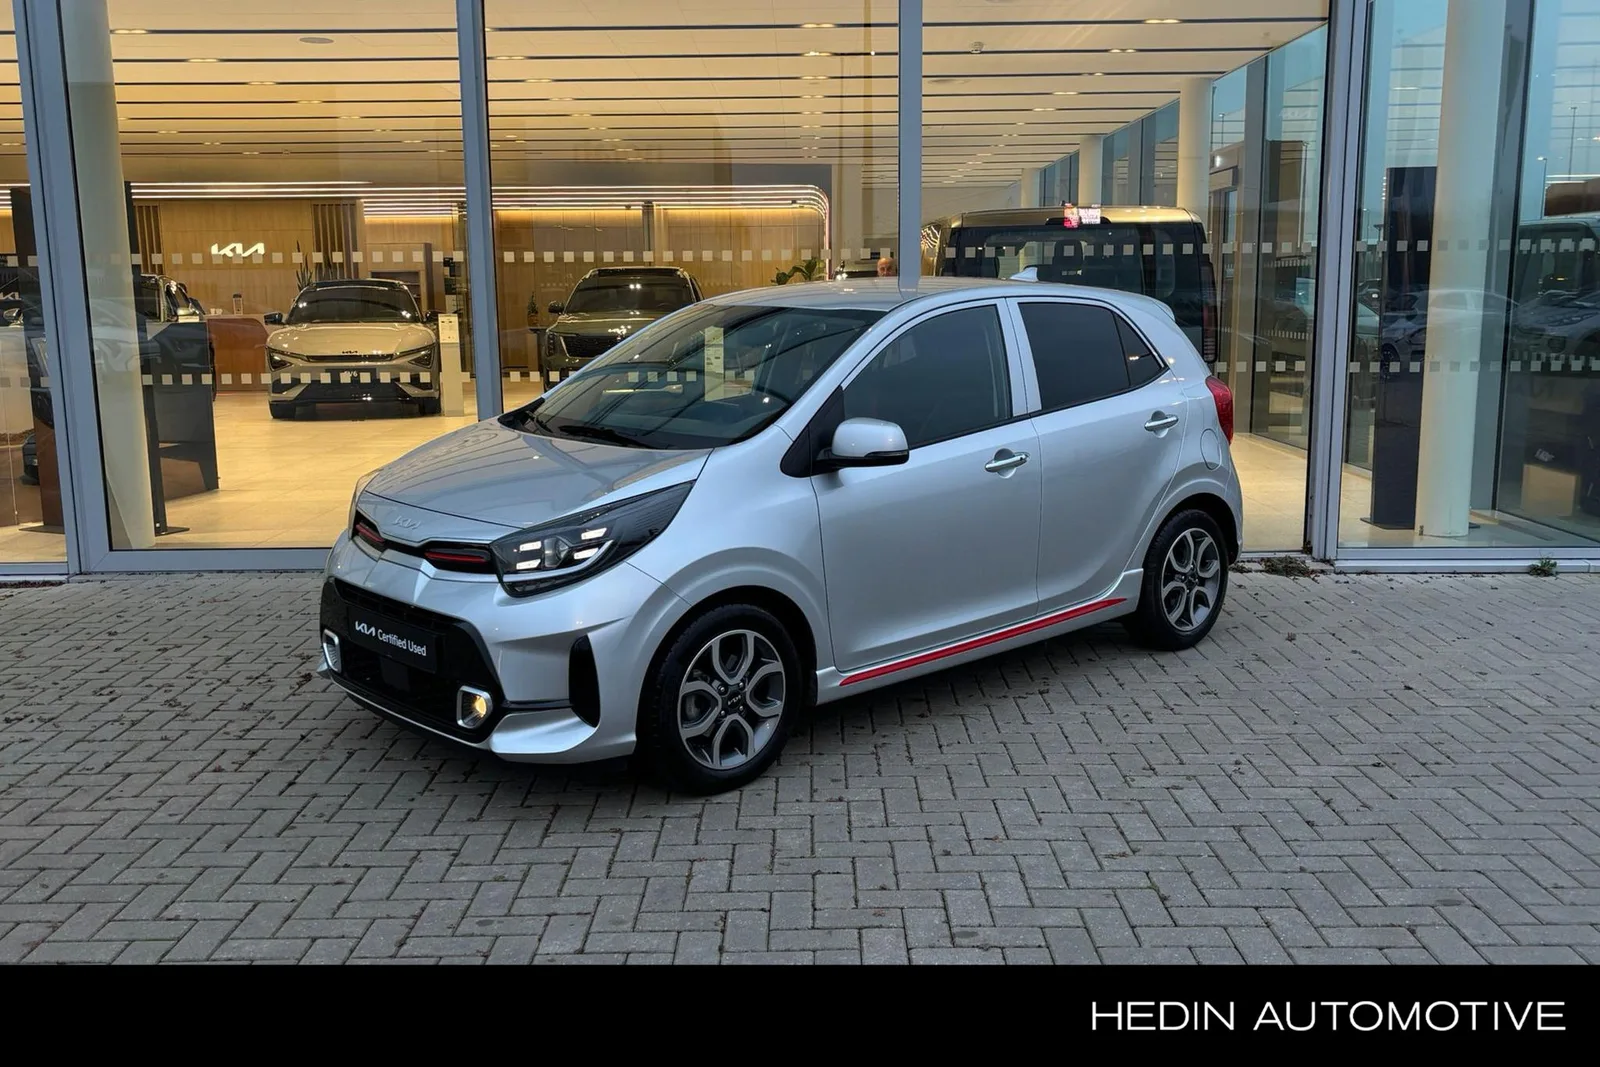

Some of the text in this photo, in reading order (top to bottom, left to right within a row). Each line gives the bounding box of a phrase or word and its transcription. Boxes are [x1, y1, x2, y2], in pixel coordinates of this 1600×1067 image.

[211, 243, 265, 257] KIA
[355, 621, 427, 657] KIA Certified Used
